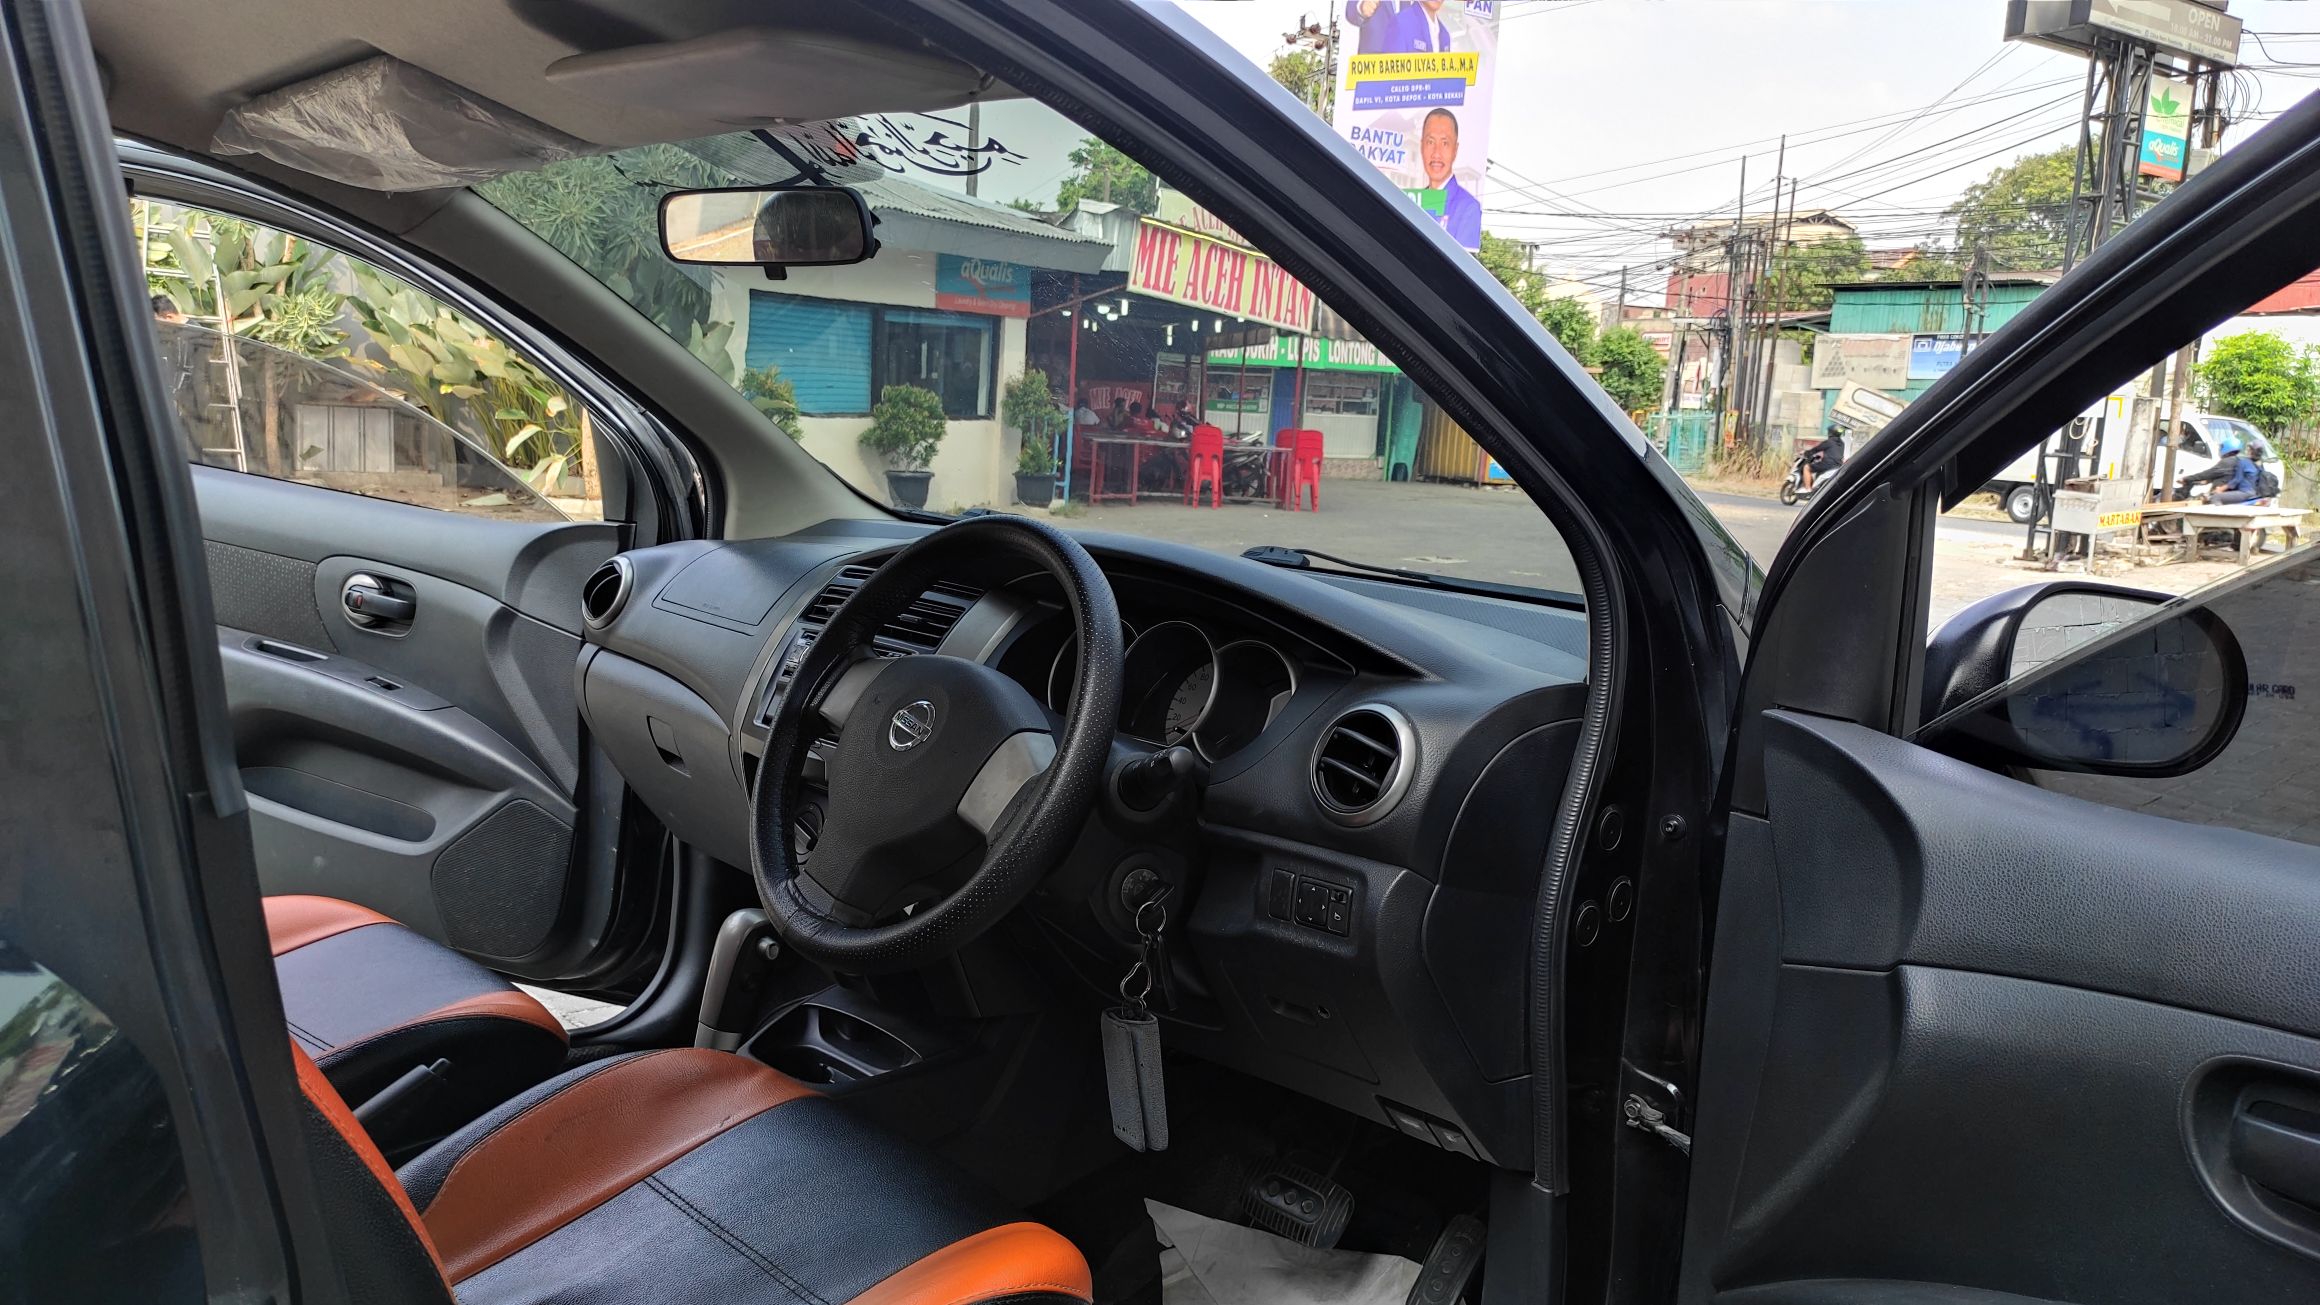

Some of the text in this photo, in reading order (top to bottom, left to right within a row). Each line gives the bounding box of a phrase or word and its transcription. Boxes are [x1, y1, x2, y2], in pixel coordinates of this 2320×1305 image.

[2188, 7, 2220, 31] OPEN
[1351, 60, 1376, 75] ROMY
[1385, 95, 1400, 103] KOTA
[1351, 126, 1403, 147] BANTU
[2148, 138, 2179, 157] aQualis
[1351, 143, 1405, 164] AKYAT
[961, 258, 1014, 286] aQualis
[1132, 224, 1313, 330] MIE ACEH INTAN
[1328, 341, 1375, 366] LONTONG
[895, 711, 924, 735] NISSAN
